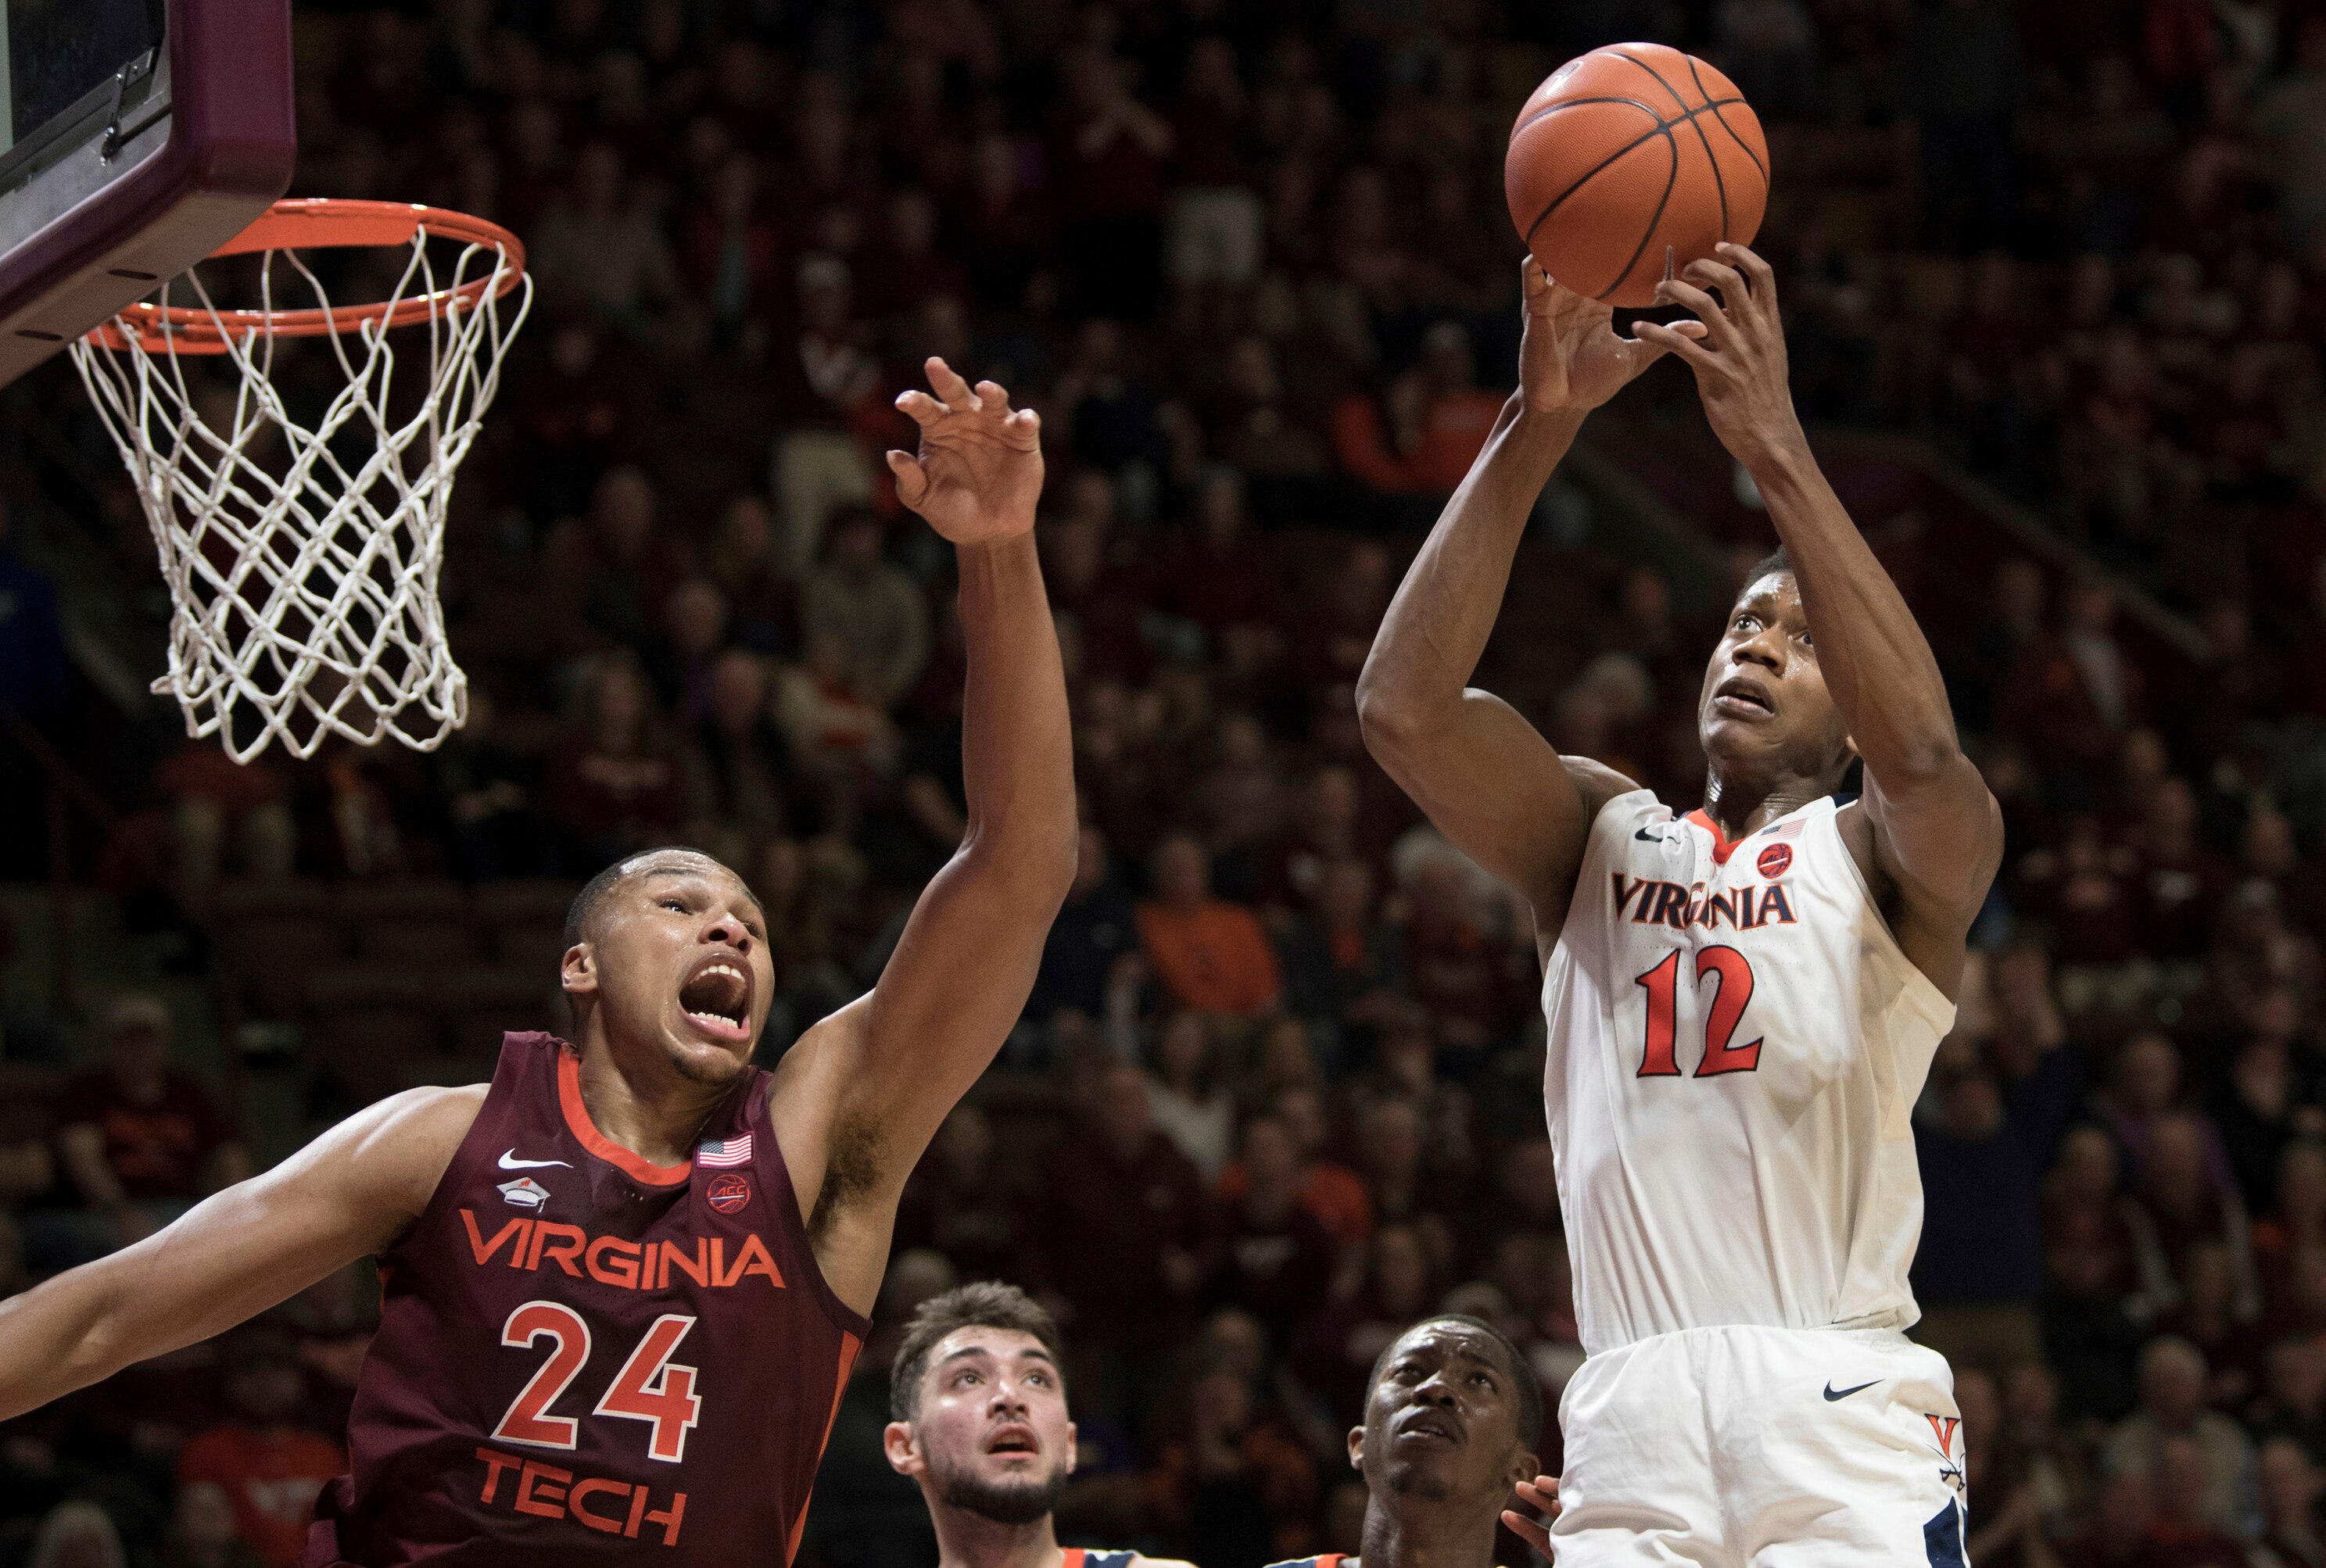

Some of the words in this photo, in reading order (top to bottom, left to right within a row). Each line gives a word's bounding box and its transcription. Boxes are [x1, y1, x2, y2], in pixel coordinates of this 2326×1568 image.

[1612, 873, 1797, 931] VIRGINIA
[1635, 944, 1764, 1079] 12
[713, 1184, 747, 1197] ACC
[459, 1208, 786, 1290] VIRGINIA
[490, 1301, 701, 1462] 24
[475, 1447, 687, 1546] TECH
